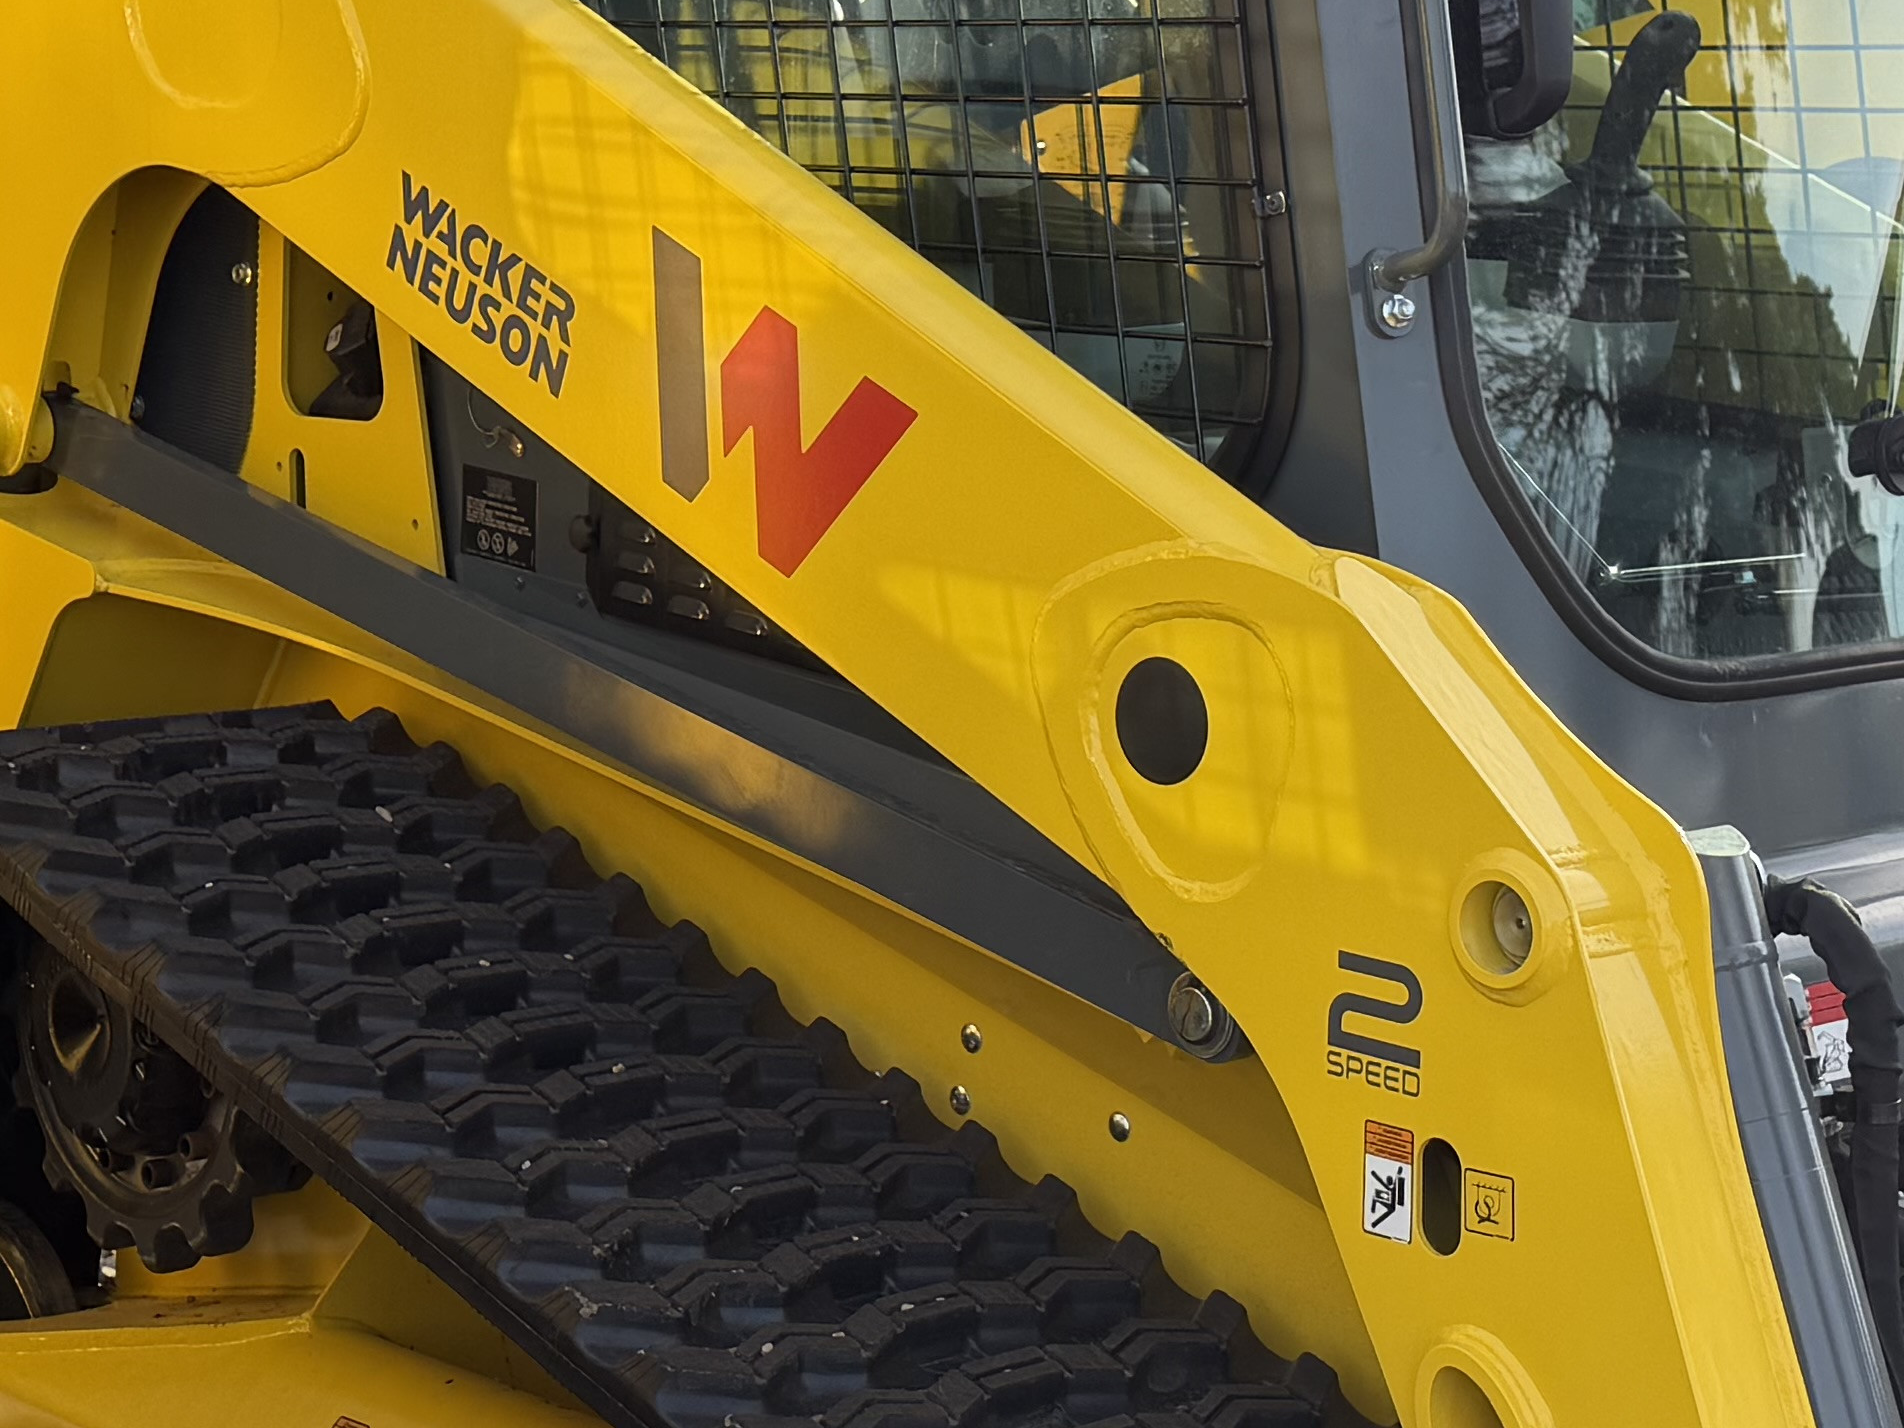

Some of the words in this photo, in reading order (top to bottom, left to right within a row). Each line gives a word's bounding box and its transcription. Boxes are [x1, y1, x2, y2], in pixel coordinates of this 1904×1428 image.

[385, 222, 570, 400] NEUSON
[400, 168, 576, 348] WACKER
[1326, 1049, 1421, 1098] SPEED
[1327, 949, 1424, 1070] 2
